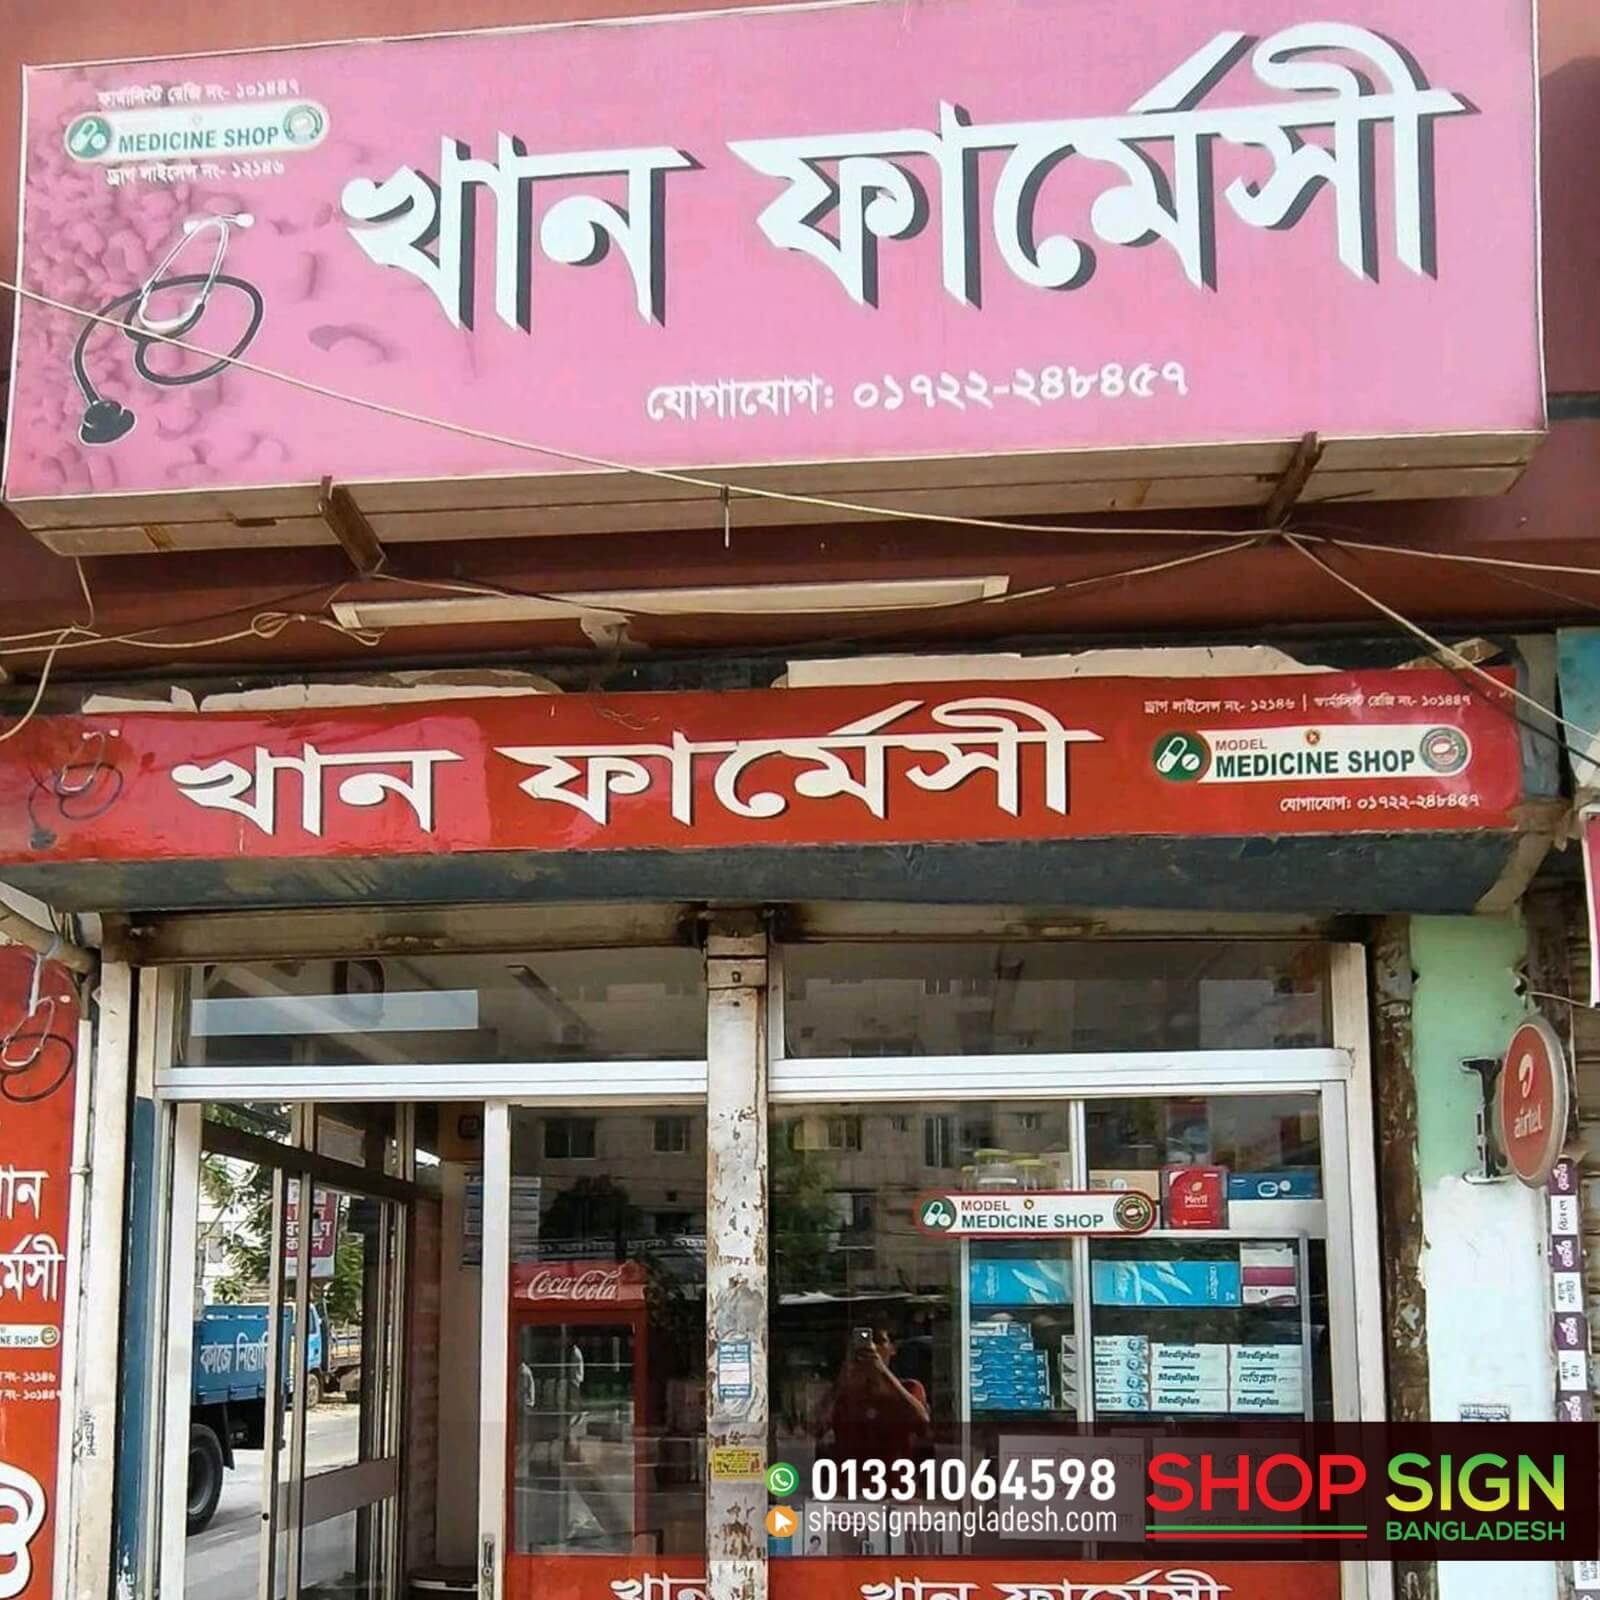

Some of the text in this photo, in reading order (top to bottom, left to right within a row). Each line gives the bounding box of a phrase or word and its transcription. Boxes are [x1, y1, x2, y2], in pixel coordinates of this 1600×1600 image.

[119, 126, 279, 153] MEDICINE SHOP
[341, 21, 1472, 335] খান ফার্মেসী
[853, 361, 1188, 411] ০১৭২২-২৪৮৪৫৭
[1215, 738, 1268, 752] MODEL
[171, 697, 1105, 836] খান ফার্মেসী
[1216, 749, 1416, 778] MEDICINE SHOP
[1356, 793, 1481, 811] ০১৭২২-২৪৮৪৫৭
[1513, 1103, 1544, 1139] airtel
[0, 1163, 50, 1220] ান
[960, 1199, 1011, 1212] MODEL
[961, 1213, 1105, 1229] MEDICINE SHOP
[527, 1262, 623, 1301] Coca-Cola
[14, 1335, 39, 1345] SHOP
[200, 1342, 235, 1375] কাজে
[1158, 1350, 1201, 1361] Mediplus
[1236, 1351, 1280, 1362] Mediplus
[1158, 1373, 1201, 1384] Mediplus
[1158, 1395, 1201, 1407] Mediplus
[1236, 1397, 1280, 1408] Mediplus
